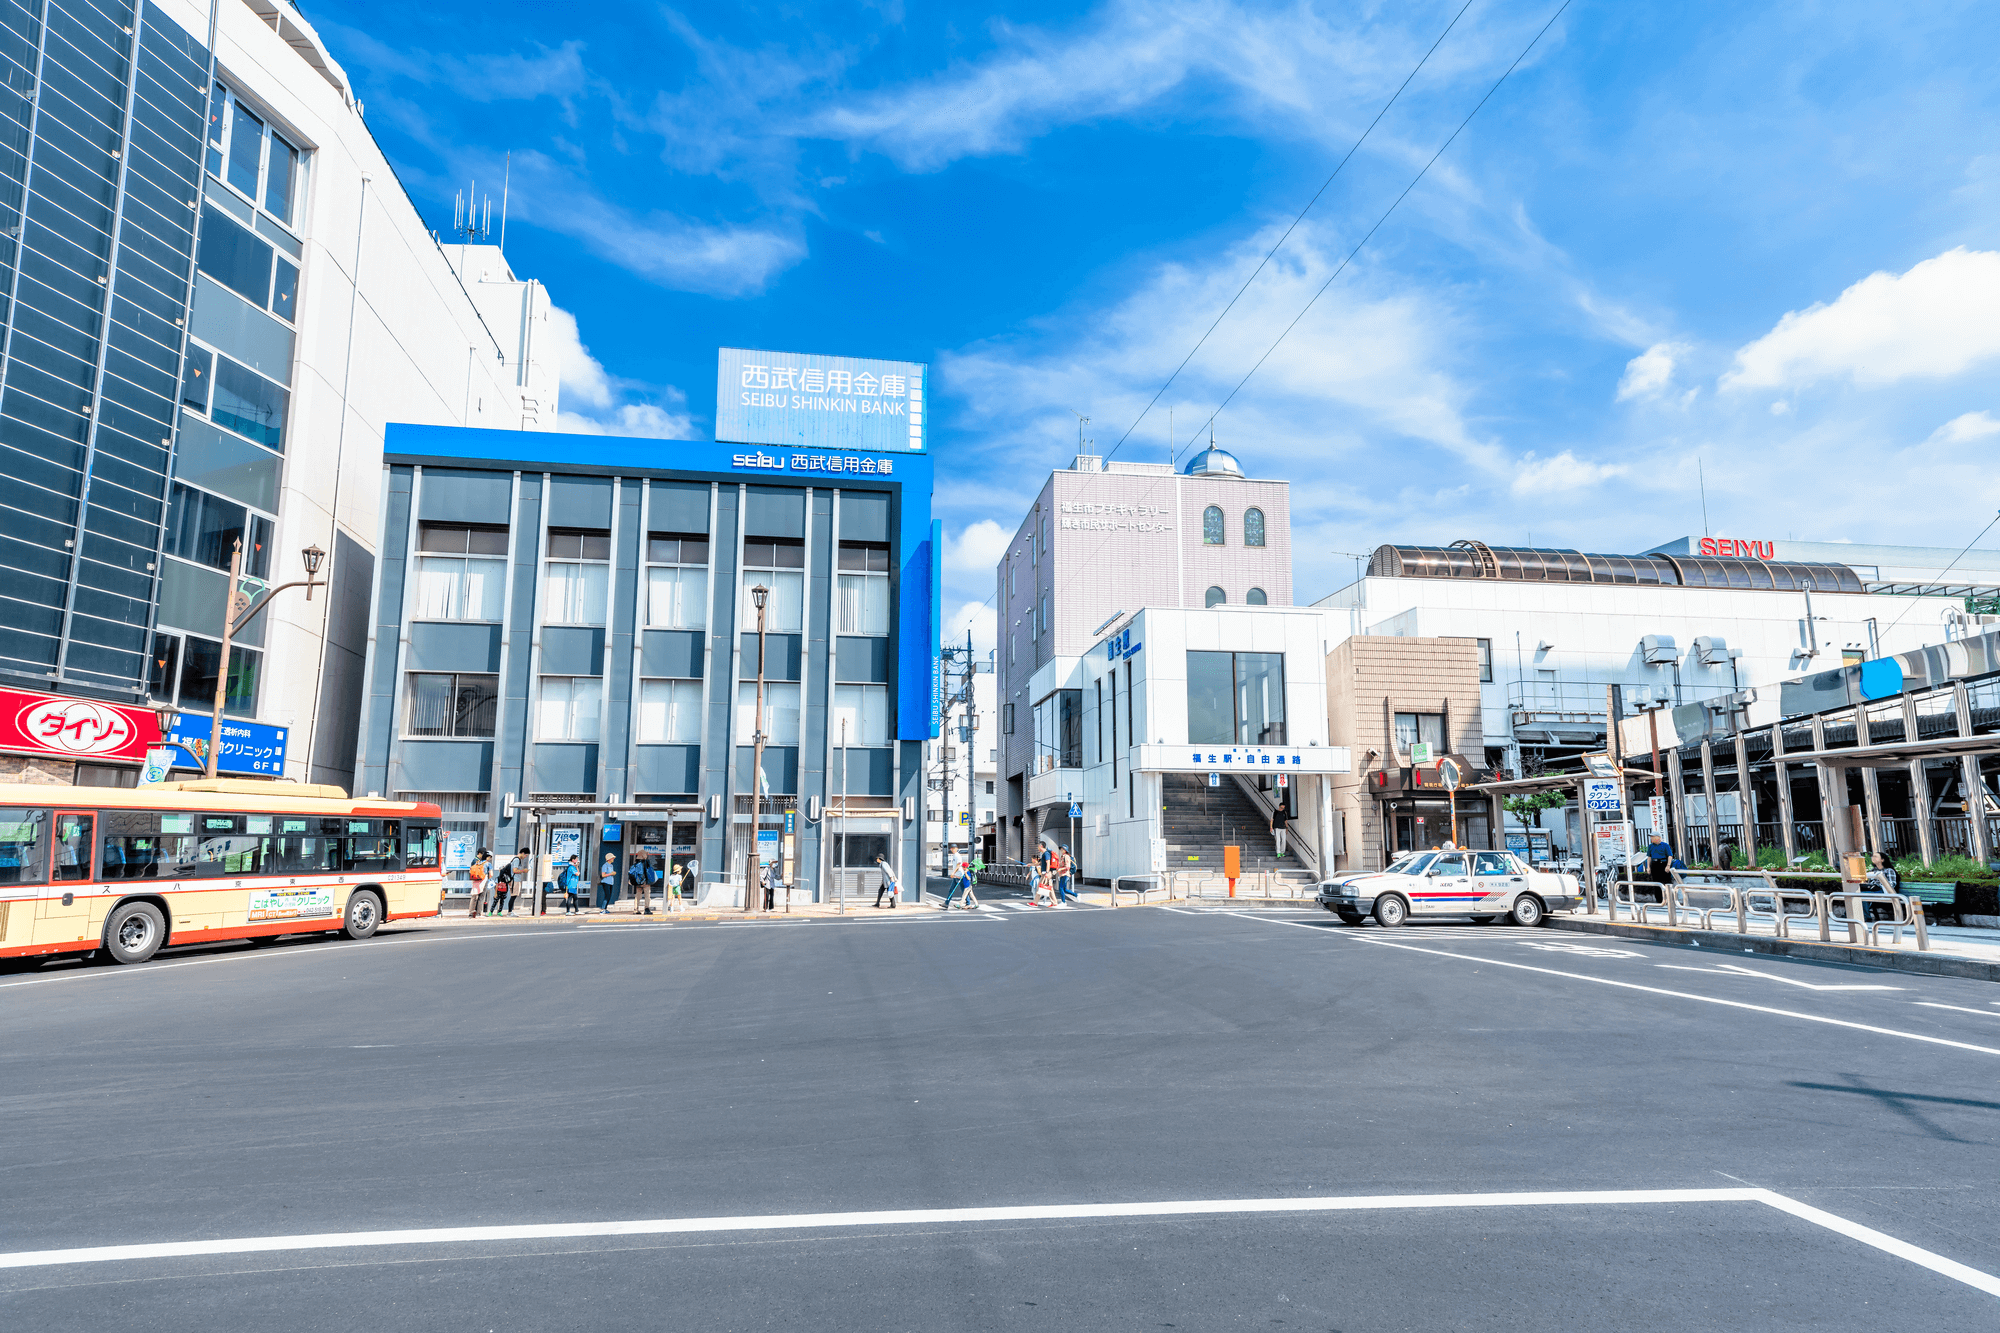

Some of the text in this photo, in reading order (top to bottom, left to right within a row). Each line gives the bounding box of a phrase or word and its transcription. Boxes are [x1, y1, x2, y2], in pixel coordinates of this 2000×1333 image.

[741, 364, 906, 398] 西武信用金庫
[741, 392, 905, 416] SEIBU SHINKIN BANK
[732, 451, 893, 475] SEIBU 西武信用金庫
[1700, 537, 1774, 561] SEIYU
[39, 712, 125, 741] ダイソー
[209, 726, 251, 739] 工透析内科
[253, 760, 270, 771] 6F
[1589, 791, 1617, 799] タクシー
[1589, 800, 1619, 809] のりば
[962, 811, 969, 824] P
[253, 895, 330, 909] こばやし クリニック
[251, 910, 266, 918] MRI
